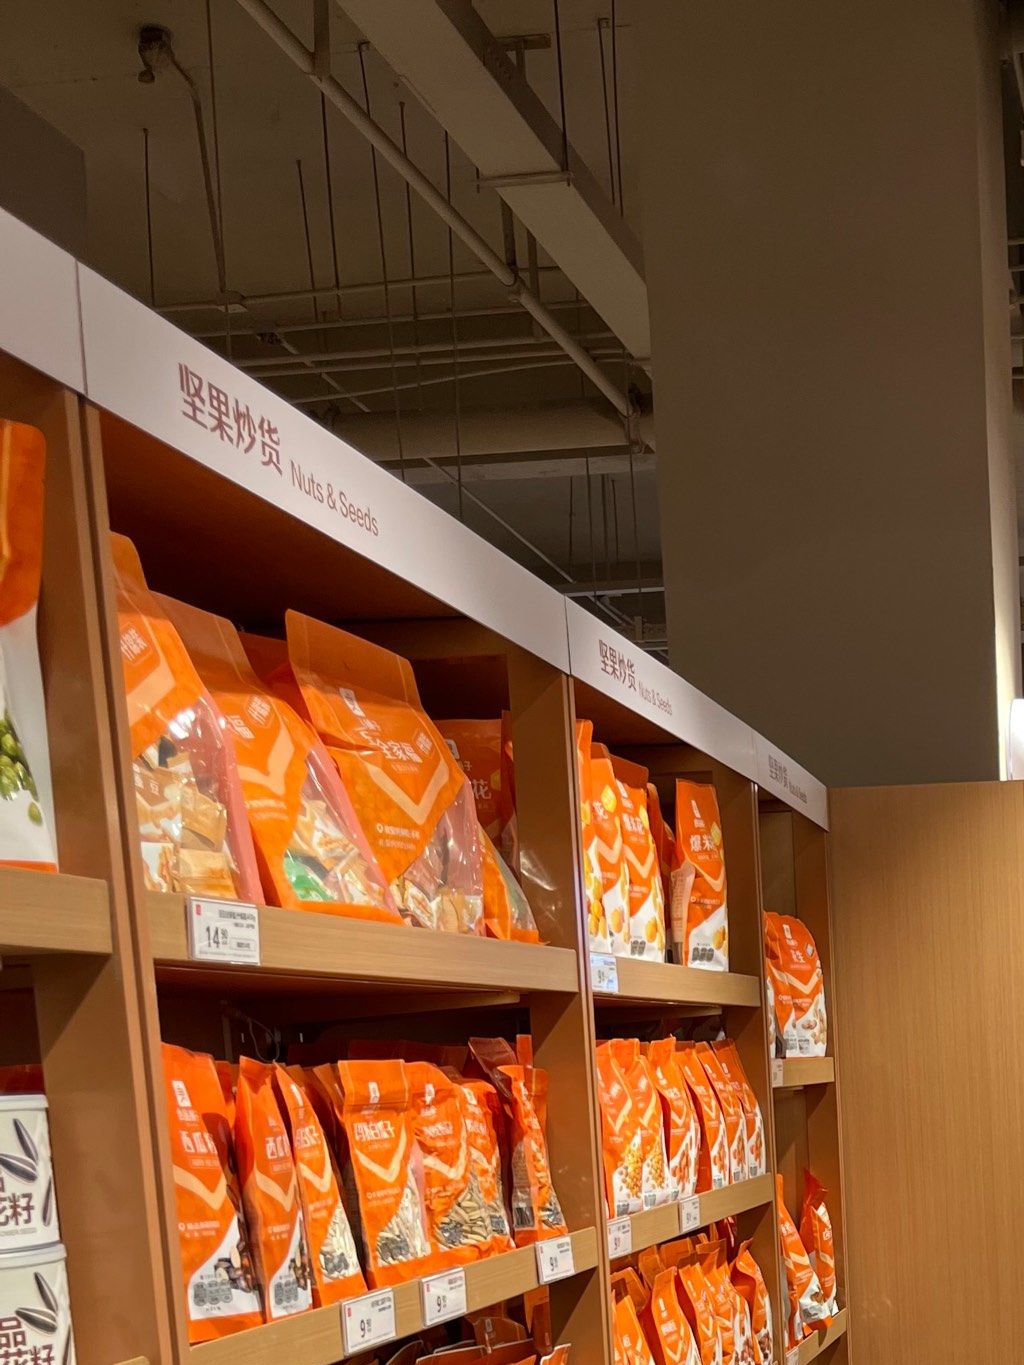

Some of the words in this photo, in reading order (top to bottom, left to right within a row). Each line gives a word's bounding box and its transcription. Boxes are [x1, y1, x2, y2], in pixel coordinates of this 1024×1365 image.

[178, 362, 283, 477] 坚果炒货
[290, 459, 325, 504] Nuts
[326, 483, 338, 512] &
[338, 491, 379, 537] Seeds
[599, 639, 637, 692] 坚果炒货
[690, 834, 717, 853] 爆米
[206, 926, 220, 948] 14
